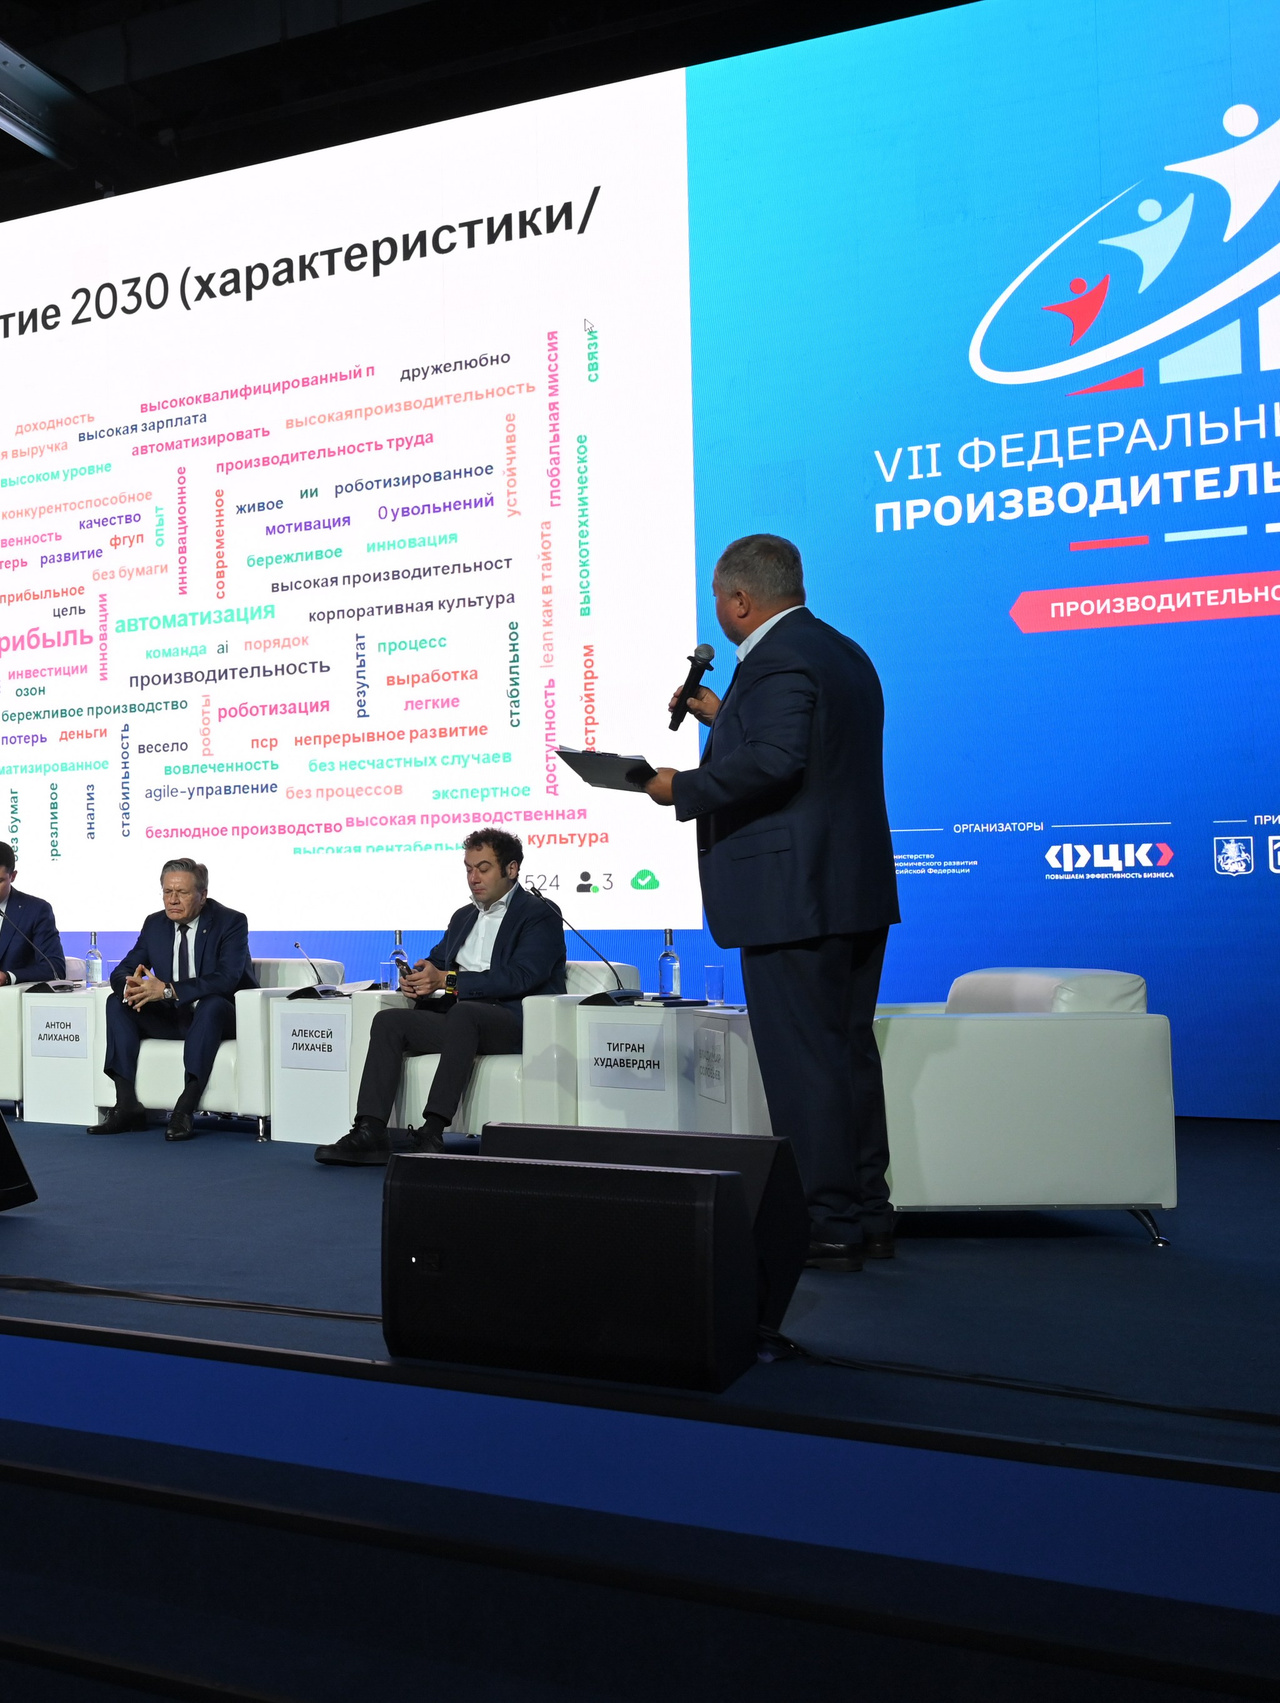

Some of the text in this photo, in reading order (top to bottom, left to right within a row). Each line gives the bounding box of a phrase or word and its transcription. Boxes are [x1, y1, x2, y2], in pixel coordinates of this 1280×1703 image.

[71, 272, 169, 325] 2030
[180, 186, 601, 311] (характеристики/
[586, 331, 598, 383] связи
[400, 353, 510, 382] дружелюбно
[285, 380, 536, 430] высокаяпроизводительность
[15, 412, 95, 436] доходность
[78, 413, 206, 443] высокая зарплата
[12, 442, 67, 458] выручка
[131, 426, 271, 457] автоматизировать
[875, 402, 1280, 482] VII ФЕДЕРАЛЬН
[217, 433, 433, 475] производительность труда
[1, 471, 60, 488] высоком
[63, 463, 112, 481] уровне
[502, 412, 521, 519] устойчивое
[335, 465, 493, 498] роботизированное
[300, 488, 318, 499] ии
[1, 491, 153, 522] конкурентоспособное
[236, 500, 283, 514] живое
[79, 513, 141, 530] качество
[177, 467, 188, 595] инновационное
[266, 516, 350, 535] мотивация
[577, 435, 591, 616] высокотехническое
[110, 534, 144, 549] фгуп
[367, 533, 458, 553] инновация
[41, 549, 103, 568] развитие
[247, 548, 343, 569] бережливое
[272, 558, 512, 592] высокая производительност
[0, 586, 85, 606] прибыльное
[115, 604, 275, 633] автоматизация
[309, 593, 515, 624] корпоративная культура
[99, 594, 109, 681] инновации
[245, 636, 308, 652] порядок
[378, 637, 447, 655] процесс
[146, 645, 207, 659] команда
[8, 665, 87, 680] инвестиции
[130, 661, 330, 691] производительность
[356, 633, 370, 718] результат
[387, 669, 478, 688] выработка
[507, 621, 520, 727] стабильное
[16, 686, 45, 697] озон
[2, 700, 188, 724] бережливое производство
[218, 700, 329, 722] роботизация
[404, 697, 460, 711] легкие
[2, 734, 47, 747] потерь
[59, 728, 107, 742] деньги
[295, 725, 488, 748] непрерывное развитие
[544, 679, 559, 796] доступность
[138, 742, 188, 754] весело
[164, 760, 279, 775] вовлеченность
[309, 752, 512, 772] без несчастных случаев
[119, 724, 130, 837] стабильность
[145, 783, 278, 801] agile-управление
[286, 785, 402, 801] без процессов
[432, 786, 530, 802] экспертное
[346, 809, 587, 828] высокая производственная
[954, 823, 1043, 833] ОРГАНИЗАТОРЫ
[146, 823, 342, 839] безлюдное производство
[528, 832, 609, 848] культура
[524, 874, 560, 891] 524
[292, 1029, 332, 1038] АЛЕКСЕЙ
[292, 1043, 332, 1052] ЛИХАЧЁВ
[607, 1042, 645, 1053] ТИГРАН
[593, 1057, 661, 1070] ХУДАВЕРДЯН
